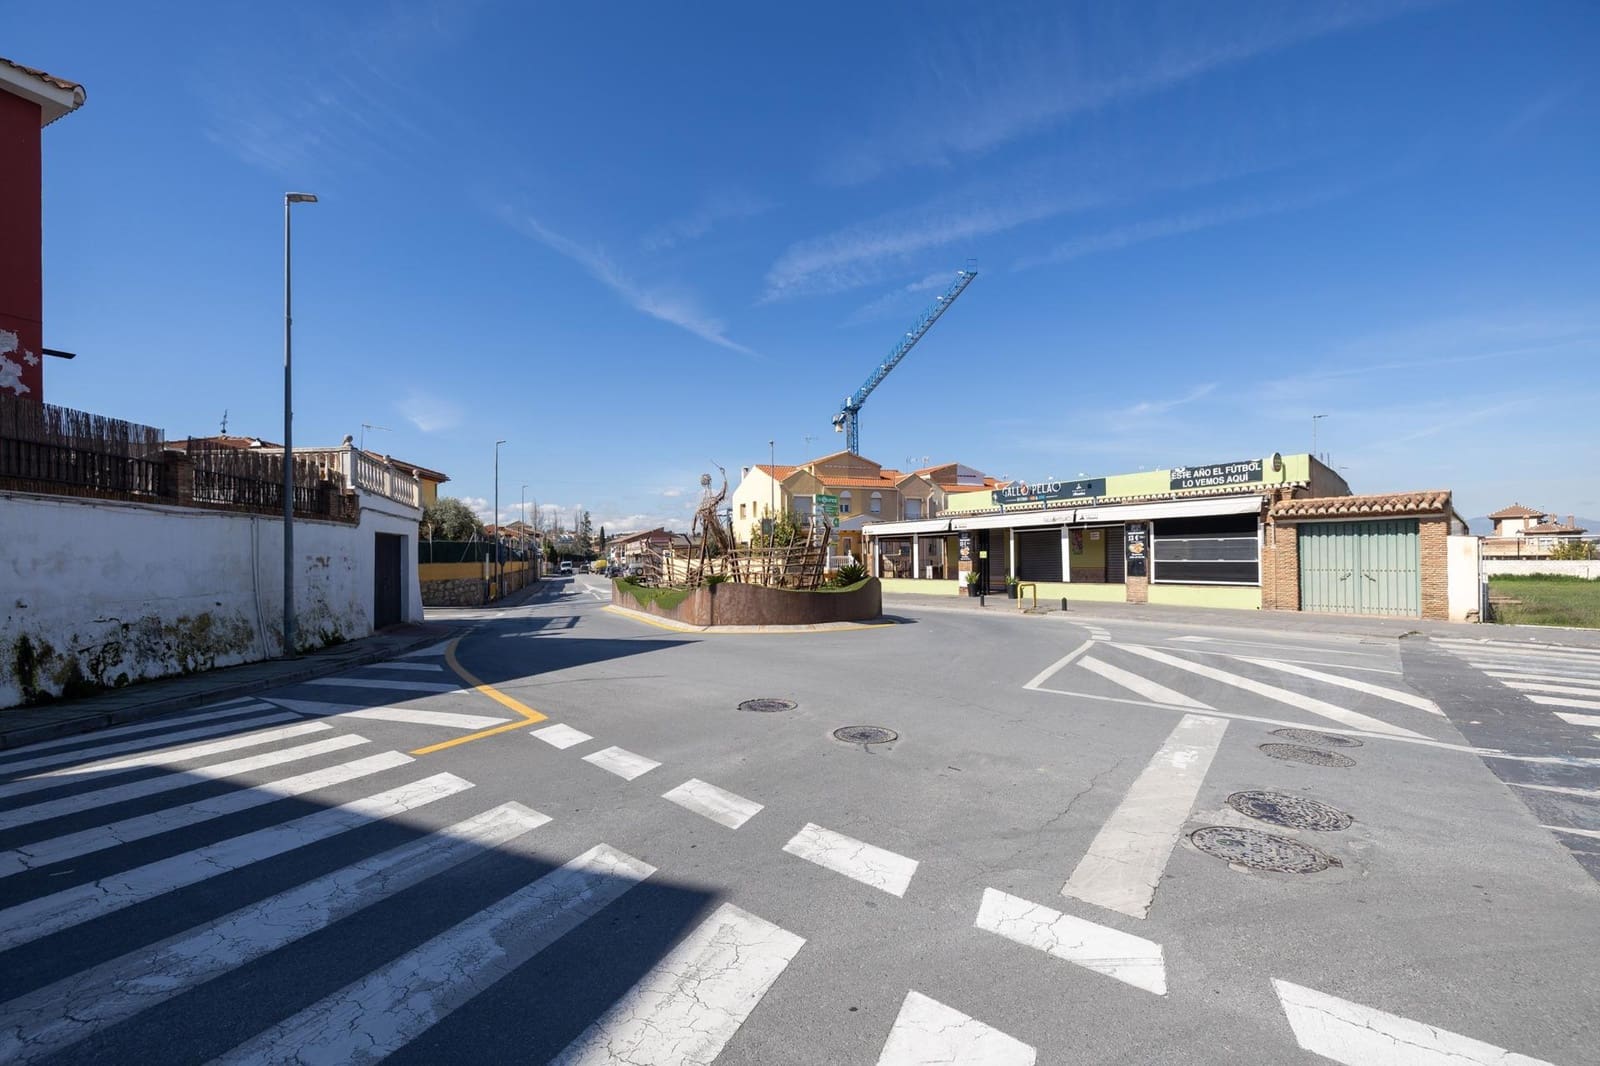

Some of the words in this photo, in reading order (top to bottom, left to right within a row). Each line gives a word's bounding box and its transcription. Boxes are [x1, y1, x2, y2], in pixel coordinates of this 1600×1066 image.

[1172, 471, 1192, 480] ESTE
[1193, 468, 1211, 478] AÑO
[1212, 467, 1224, 476] EL
[1225, 462, 1261, 474] FÚTBOL
[1182, 479, 1194, 488] LO
[1195, 477, 1225, 486] VEMOS
[1227, 472, 1249, 483] AQUÍ
[1002, 485, 1029, 497] GALLO
[1031, 481, 1061, 495] PELAO
